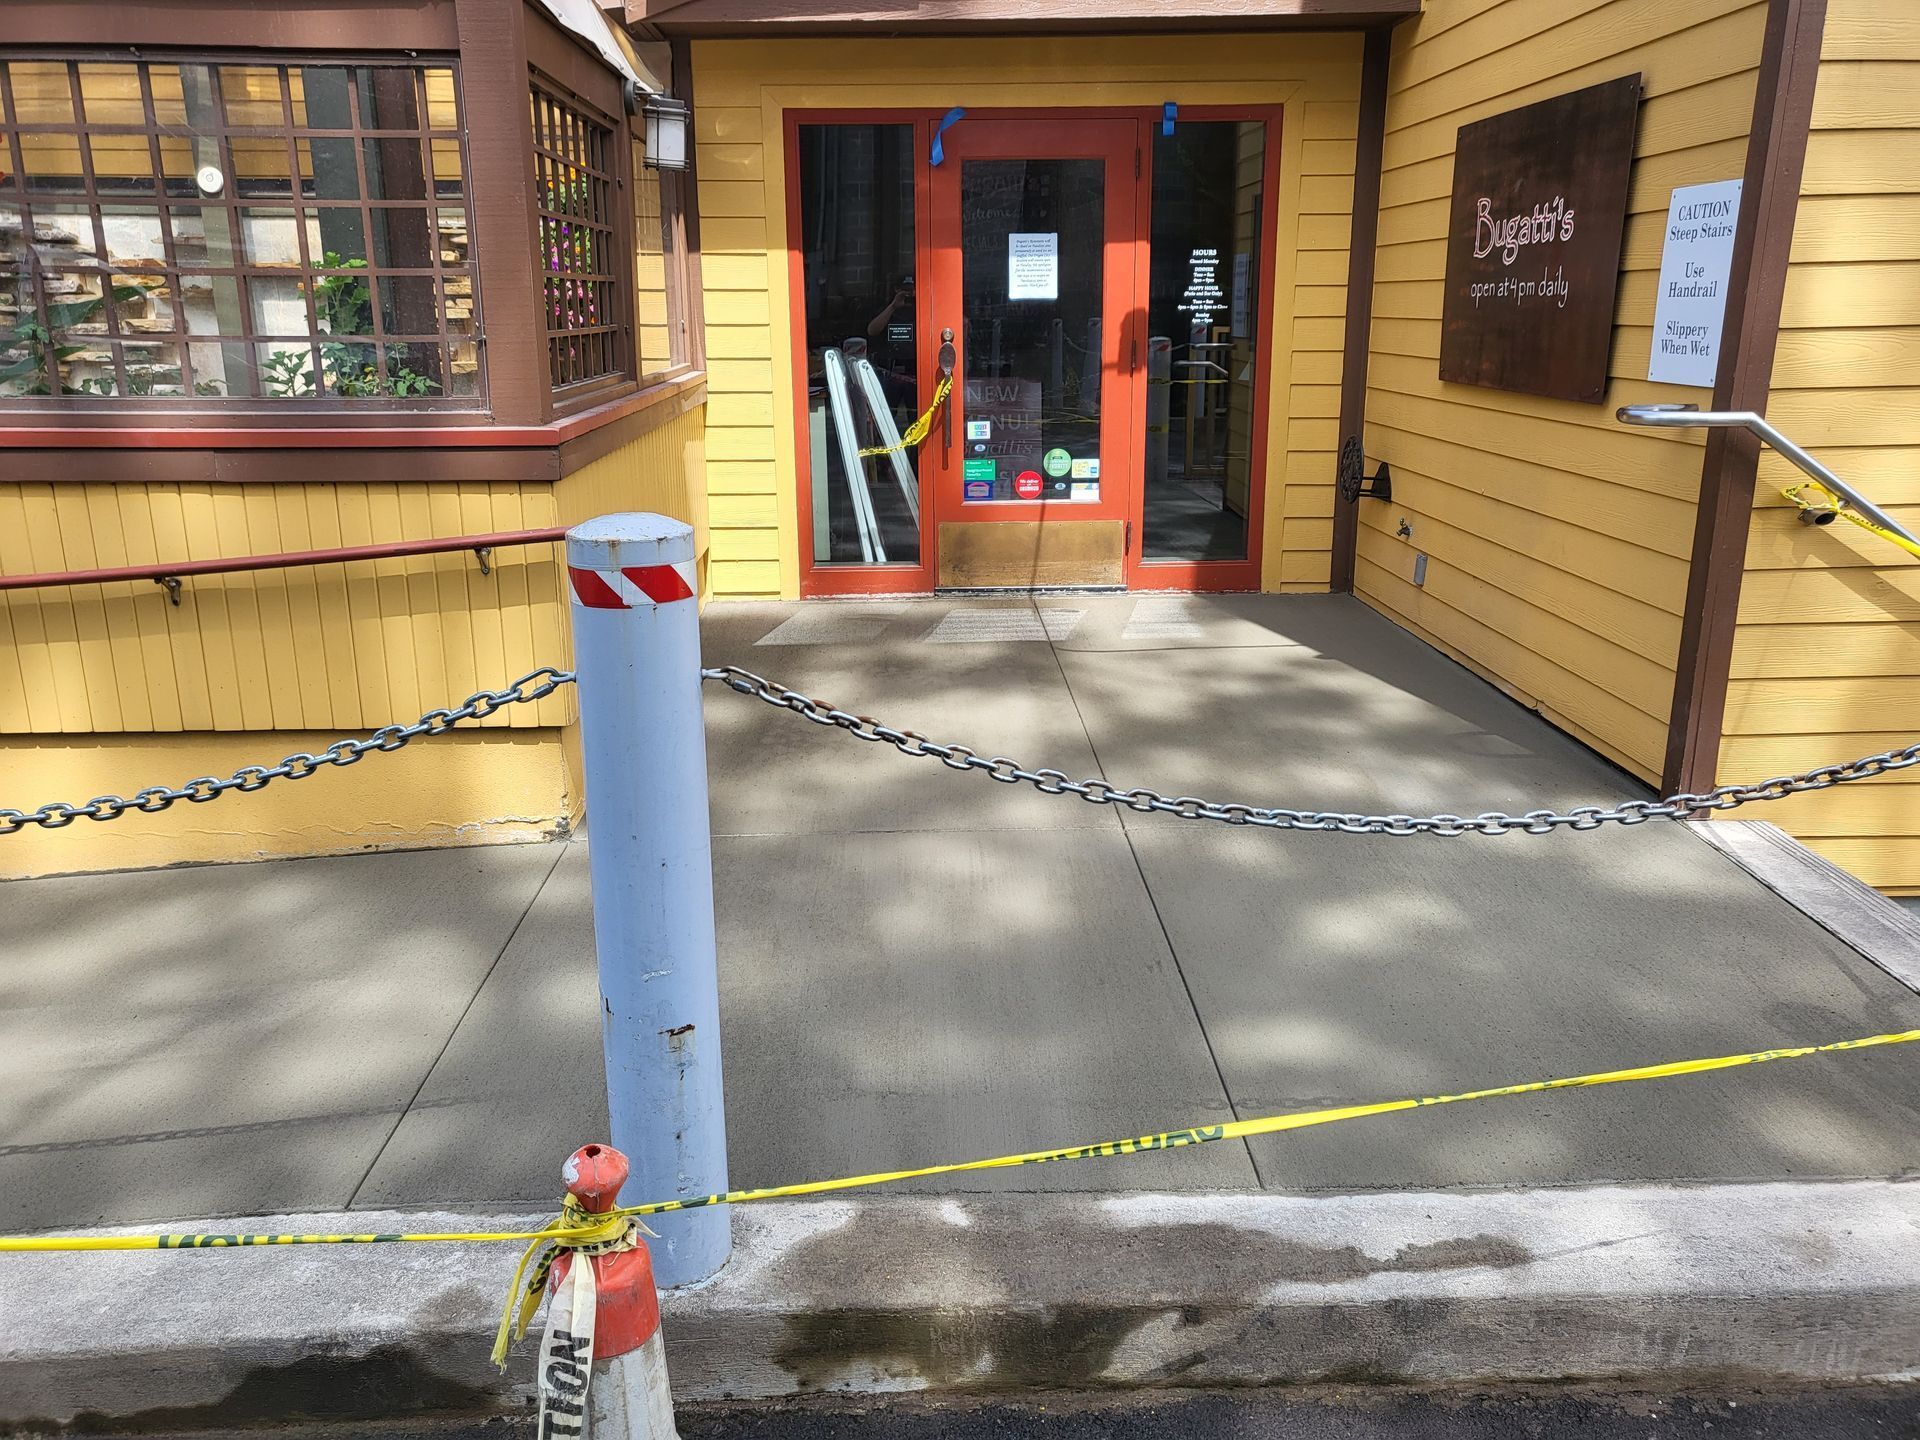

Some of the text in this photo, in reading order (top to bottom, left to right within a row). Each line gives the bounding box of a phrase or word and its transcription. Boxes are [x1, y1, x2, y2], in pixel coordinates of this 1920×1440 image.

[1678, 200, 1731, 221] CAUTION
[1473, 196, 1575, 265] Bugatti's
[1669, 222, 1733, 243] Steep Stairs
[1685, 262, 1704, 278] Use
[1471, 283, 1495, 309] open
[1538, 265, 1569, 308] daily
[1668, 281, 1718, 298] Handrail
[1666, 320, 1709, 340] Slippery
[1660, 338, 1710, 357] When Wet
[967, 385, 1019, 402] NEW
